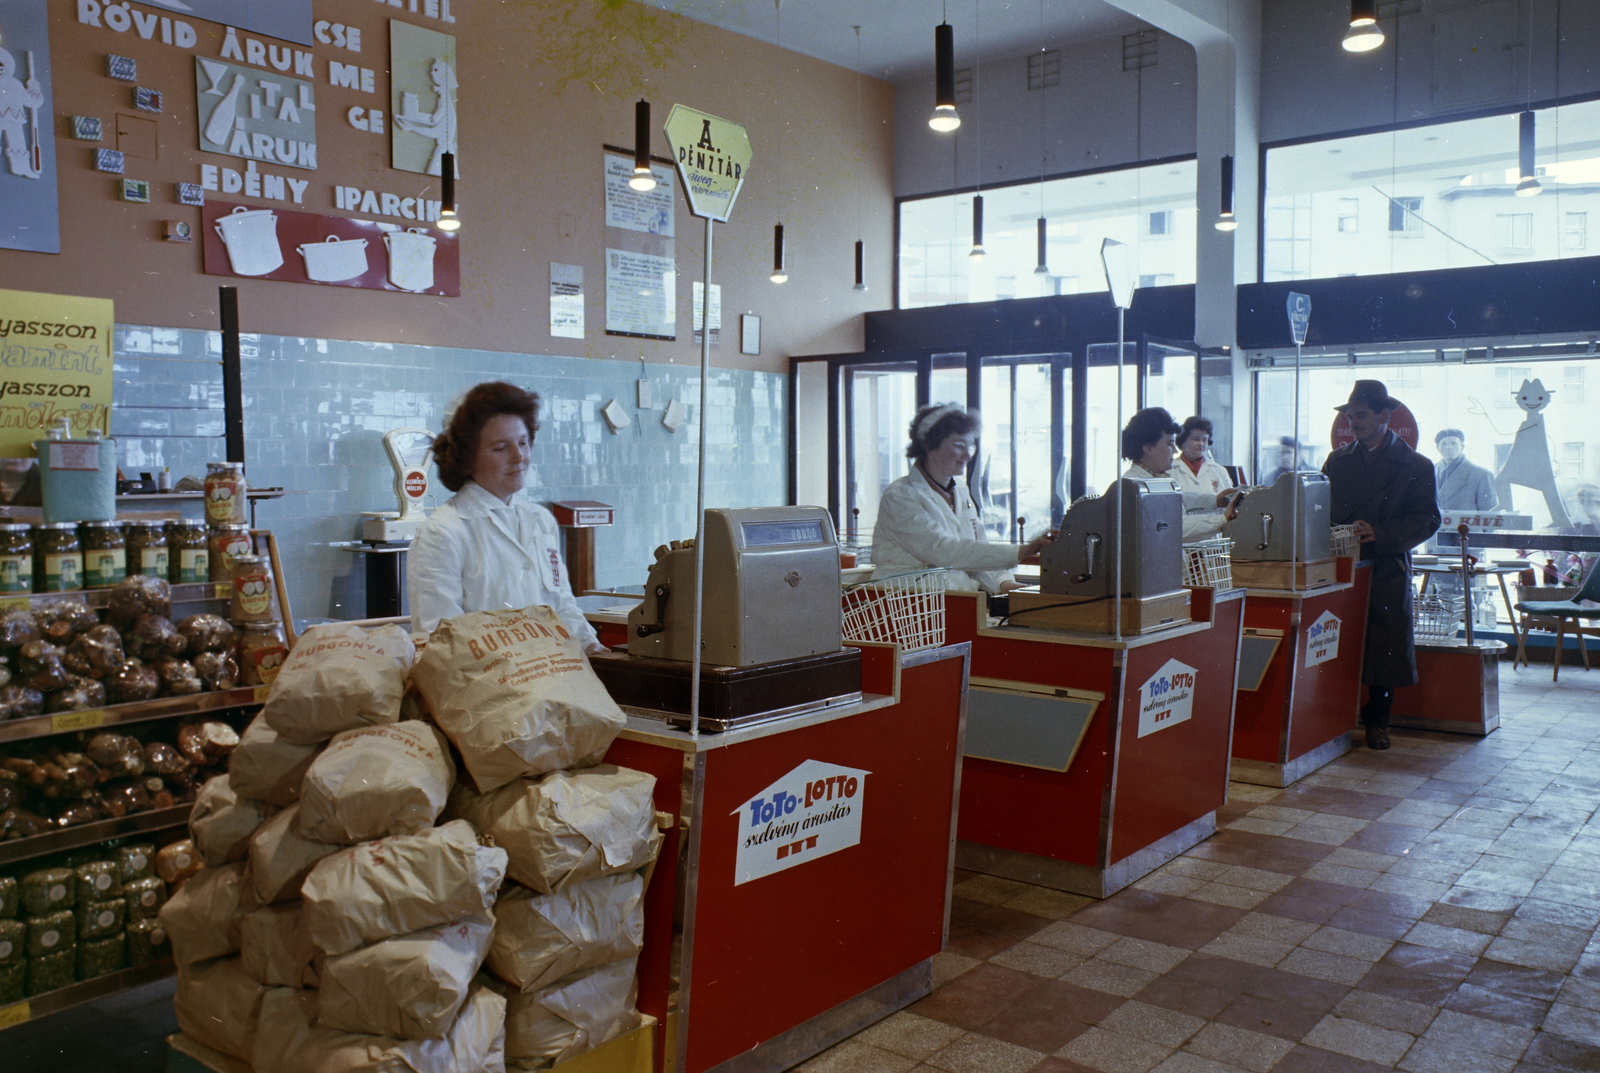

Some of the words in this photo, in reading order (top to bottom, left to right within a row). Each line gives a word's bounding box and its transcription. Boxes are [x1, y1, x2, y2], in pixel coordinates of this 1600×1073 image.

[77, 0, 197, 49] RÖVID
[220, 26, 314, 78] ÁRUK
[314, 20, 361, 52] CSE
[329, 61, 375, 93] ME
[250, 80, 315, 124] ITAL
[348, 106, 384, 134] GE
[229, 116, 317, 168] ÁRUK
[697, 119, 721, 153] A.
[679, 144, 742, 180] PÉNZTÁR
[202, 160, 309, 204] EDÉNY
[335, 185, 458, 222] IPARCIK
[466, 620, 571, 660] BURGONA
[743, 820, 800, 848] szelvény
[802, 802, 851, 830] árusítás
[776, 834, 819, 860] ITT
